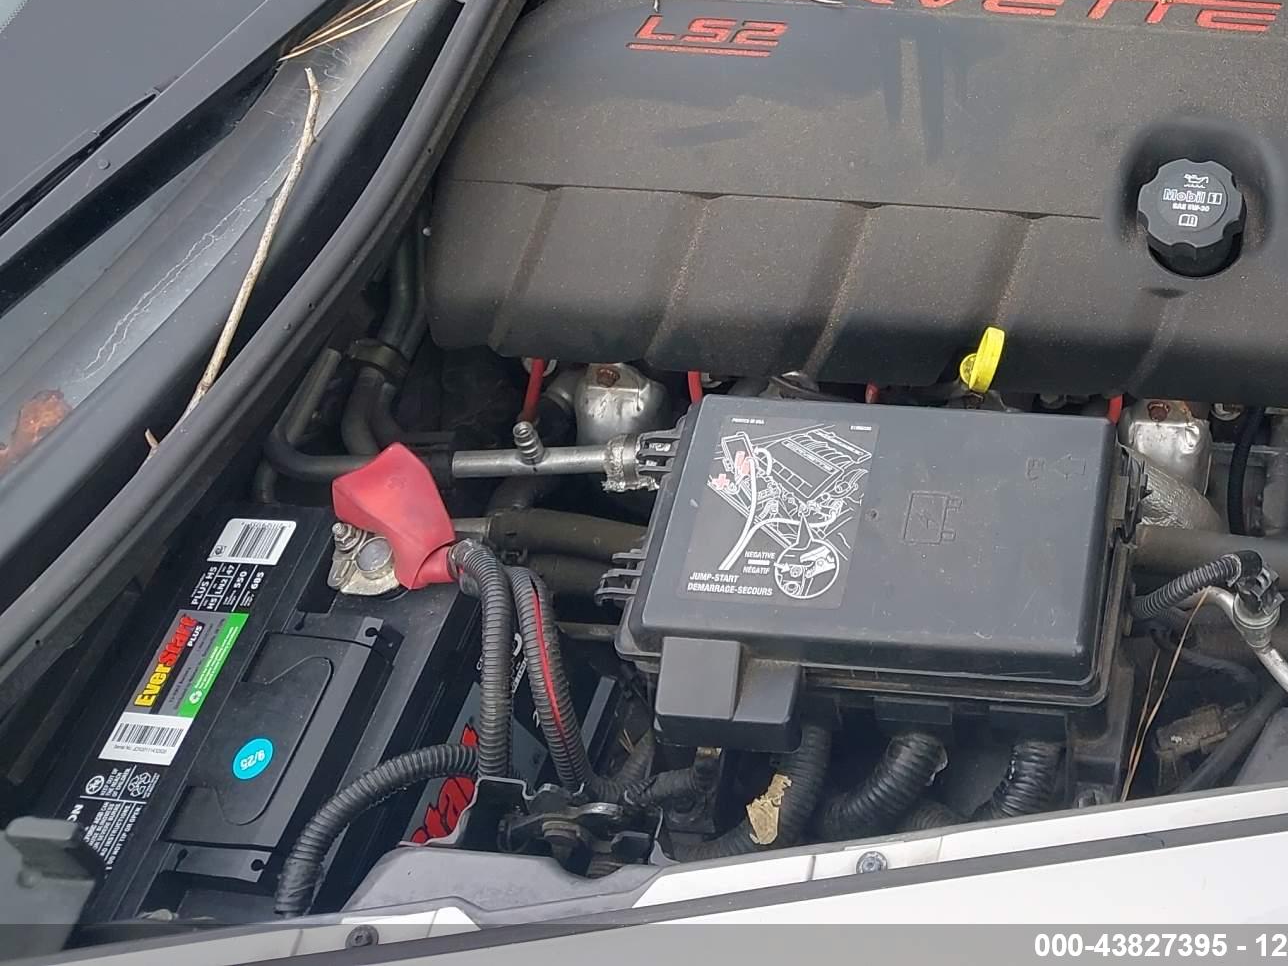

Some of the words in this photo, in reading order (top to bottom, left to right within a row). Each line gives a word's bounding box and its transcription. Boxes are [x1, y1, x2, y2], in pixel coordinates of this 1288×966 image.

[629, 15, 789, 51] LS2
[1162, 188, 1206, 204] Mobil
[744, 550, 776, 560] NEGATIVE
[226, 564, 235, 575] 47
[689, 571, 740, 583] JUMP-START
[214, 578, 228, 595] LN2
[233, 571, 248, 588] 550
[190, 581, 210, 605] PLUS
[186, 625, 203, 647] PLUS
[134, 616, 198, 708] EverStart
